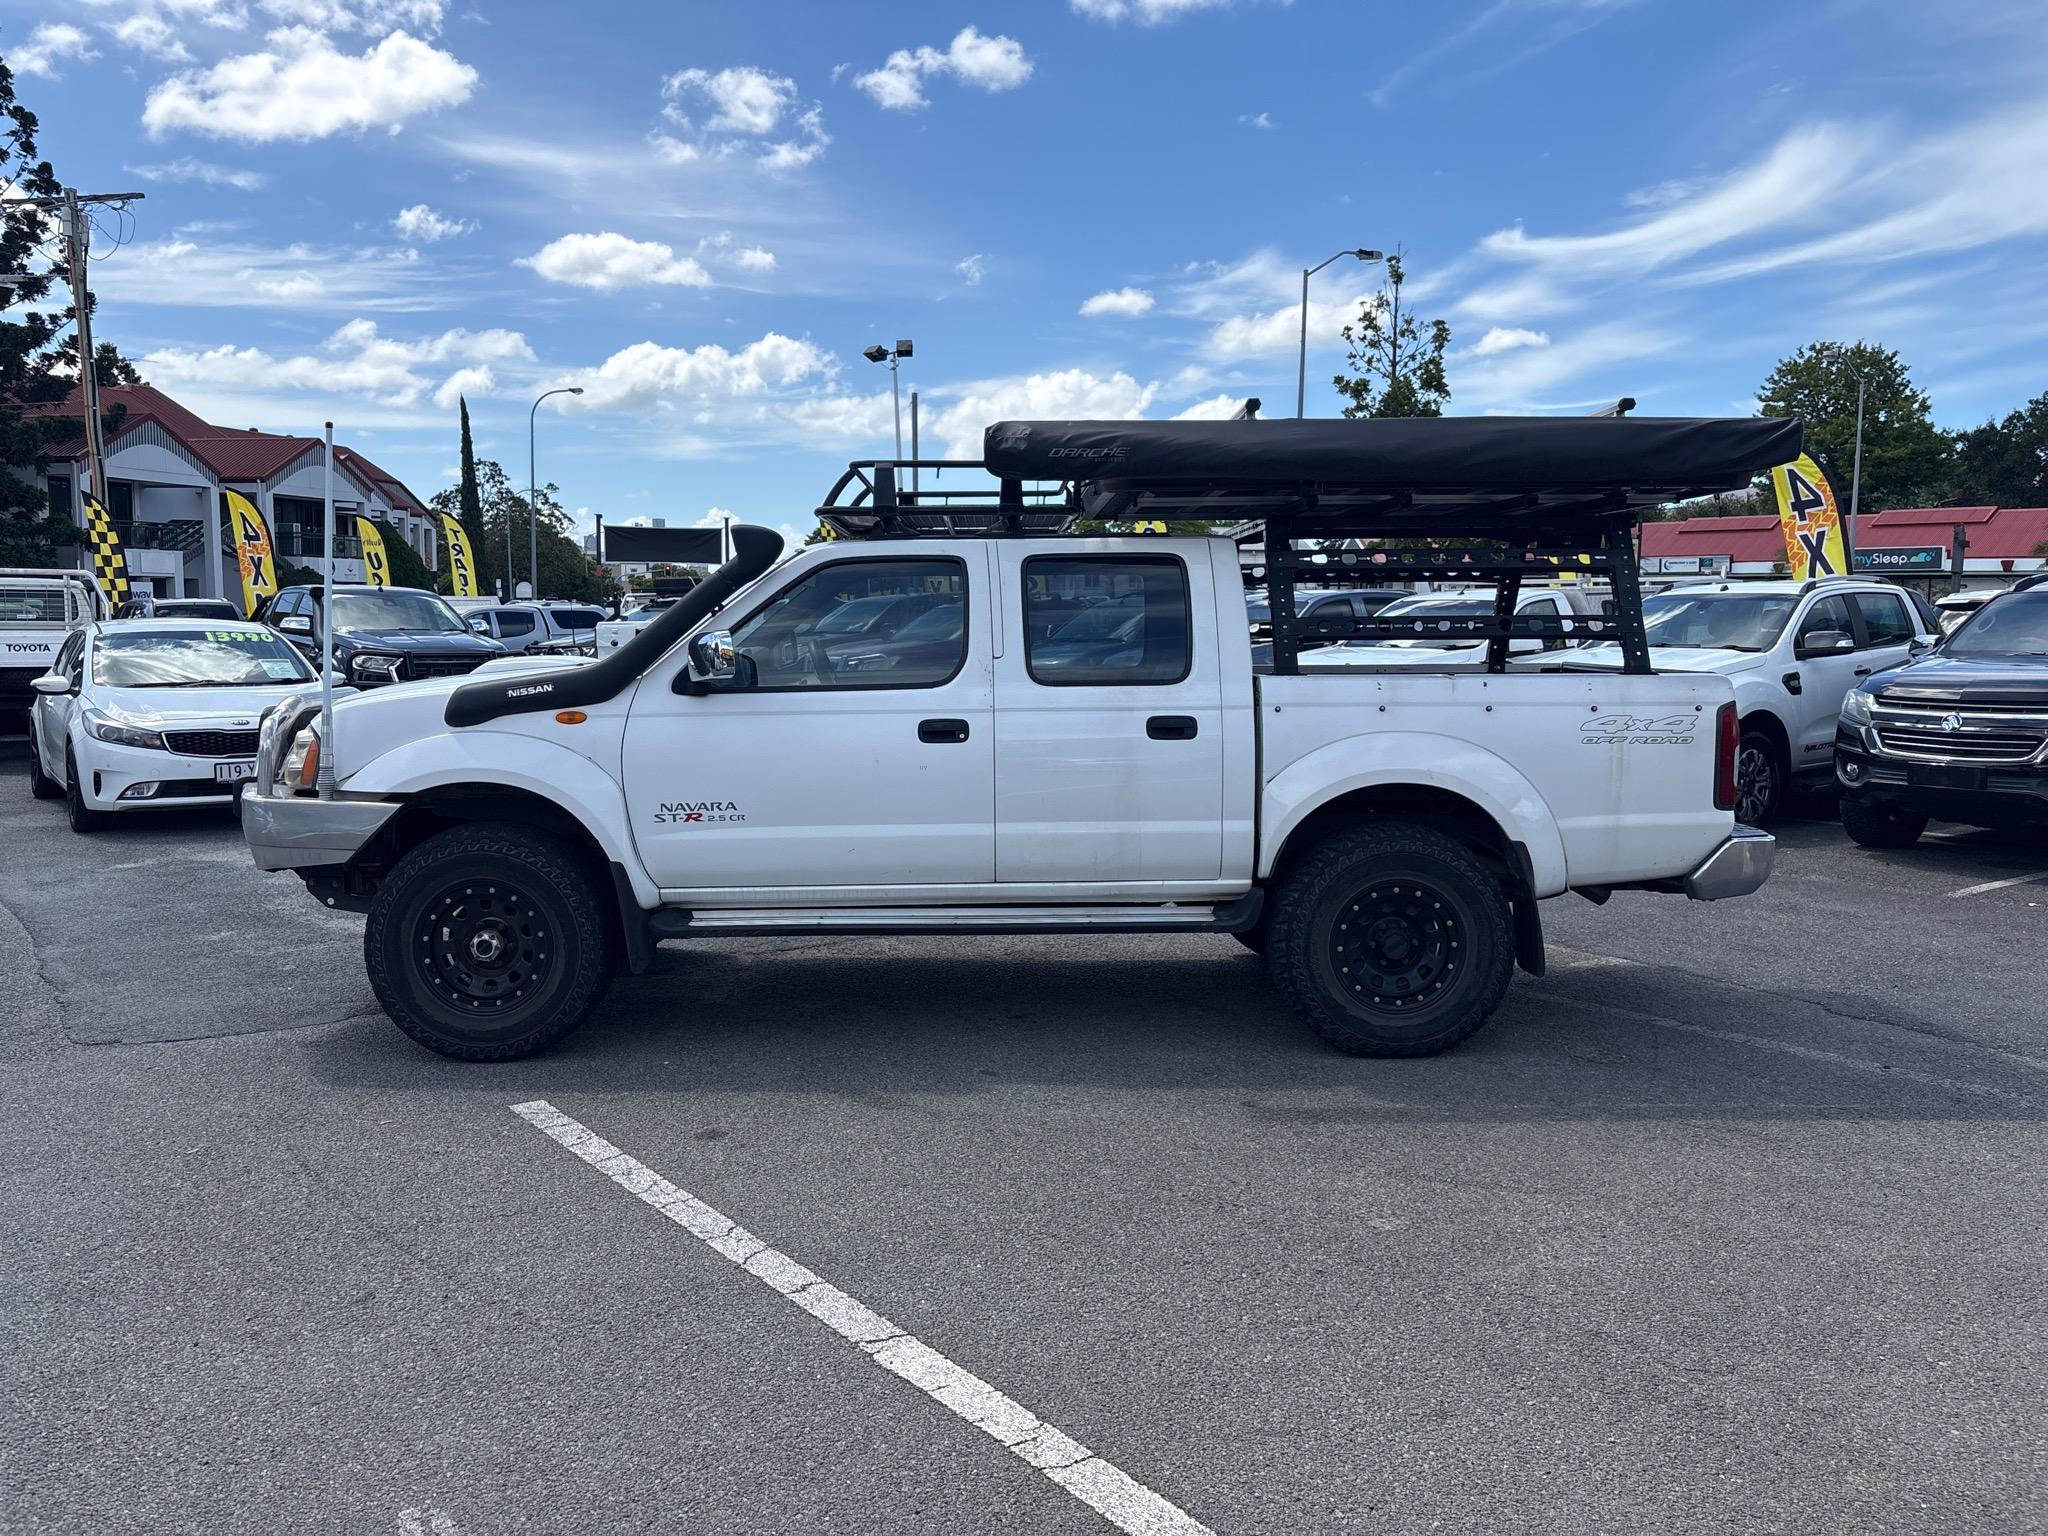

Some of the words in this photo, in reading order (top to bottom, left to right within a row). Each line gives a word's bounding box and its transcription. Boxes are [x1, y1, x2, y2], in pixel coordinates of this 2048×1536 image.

[1048, 447, 1130, 457] DARCHE
[205, 631, 274, 642] 13990
[6, 644, 51, 652] TOYOTA
[508, 684, 553, 697] NISSAN
[1581, 736, 1628, 744] OFF
[1629, 736, 1694, 744] ROAD
[660, 802, 738, 812] NAVARA
[654, 813, 705, 823] ST-R
